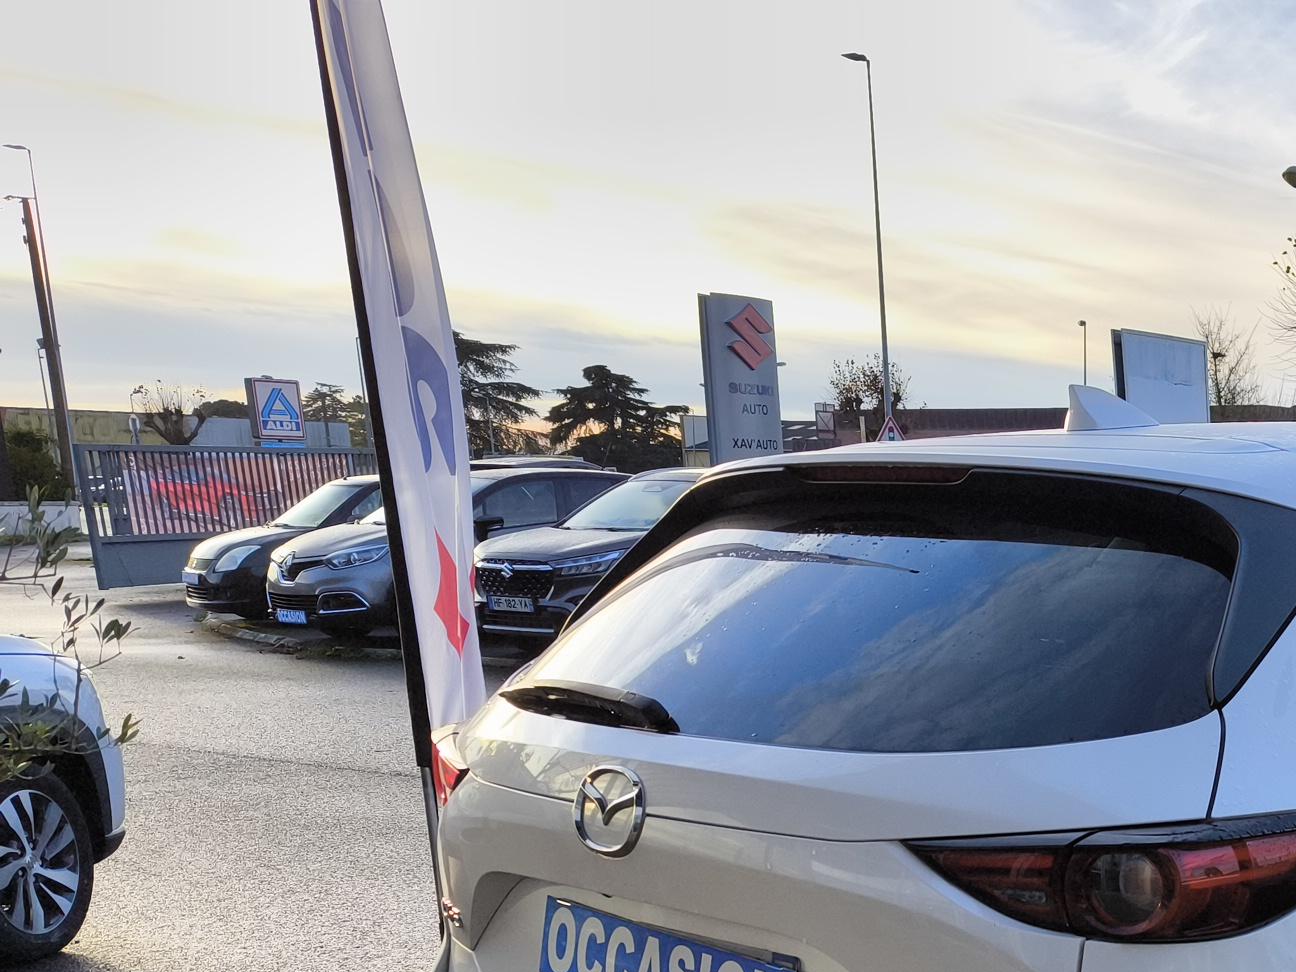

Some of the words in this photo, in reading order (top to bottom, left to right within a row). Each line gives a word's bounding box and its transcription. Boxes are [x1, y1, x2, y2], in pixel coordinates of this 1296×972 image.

[728, 382, 775, 396] SUZUKI
[742, 403, 768, 415] AUTO
[266, 420, 297, 431] ALDI
[732, 438, 778, 450] XAV'AUTO
